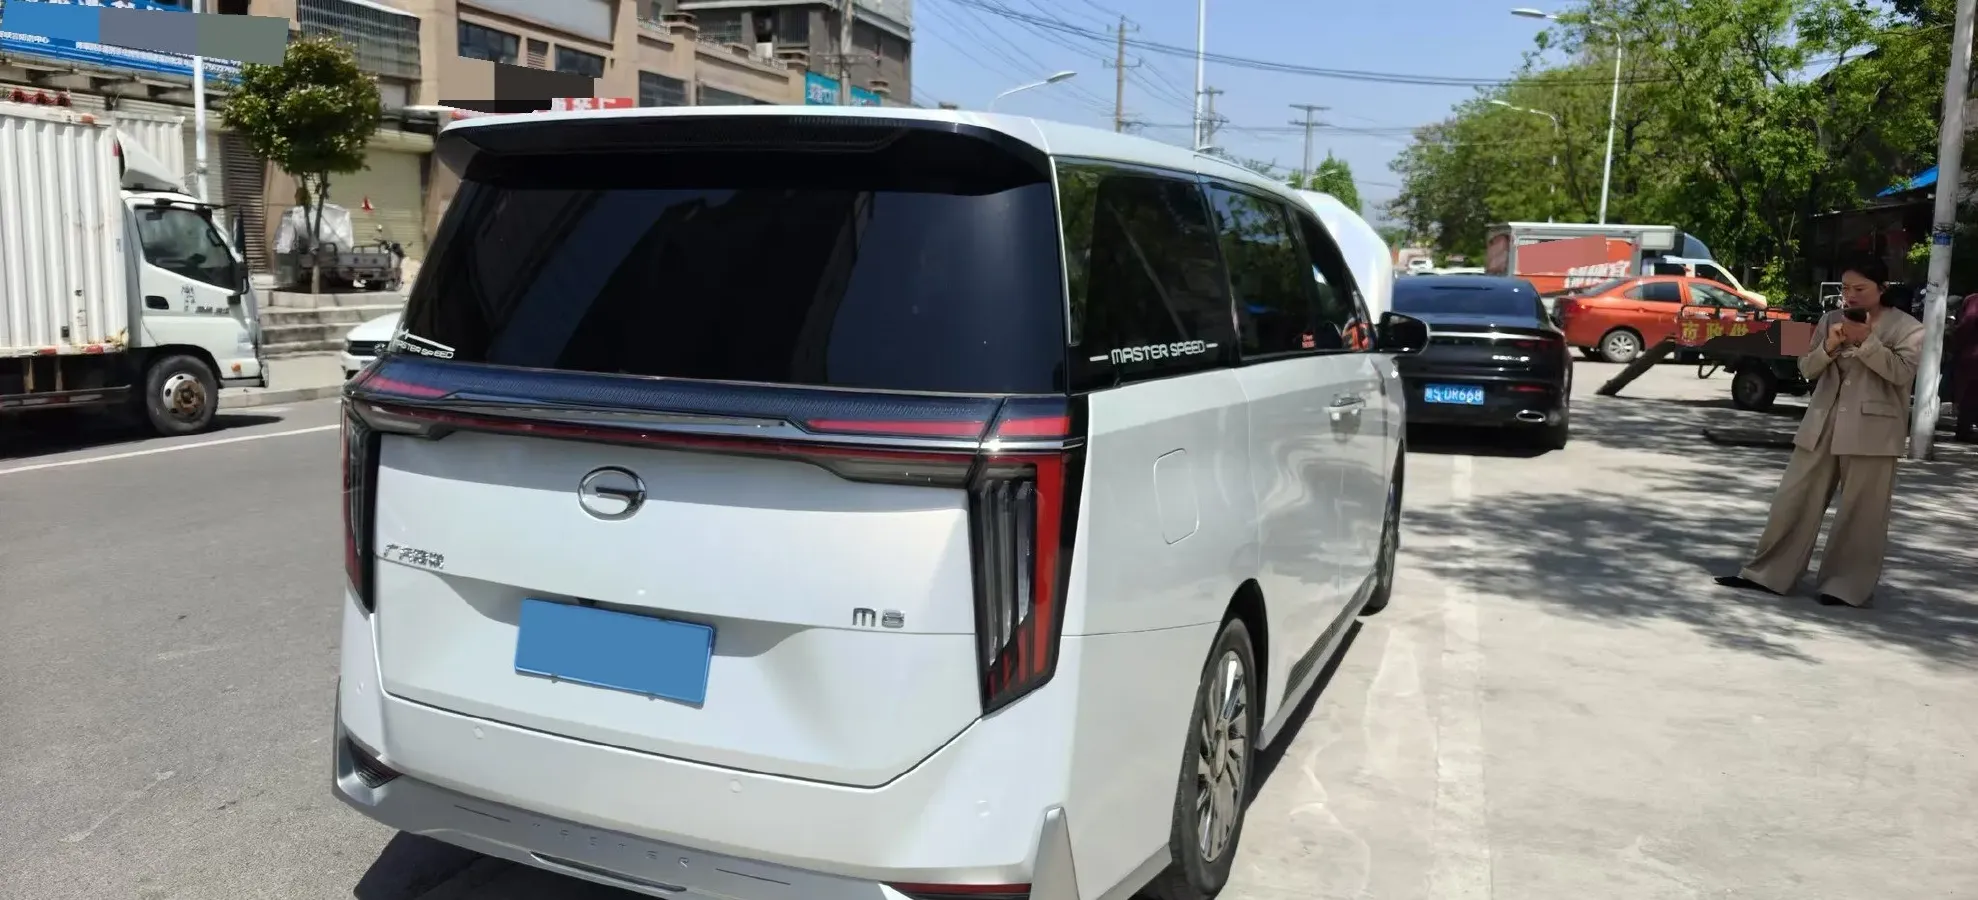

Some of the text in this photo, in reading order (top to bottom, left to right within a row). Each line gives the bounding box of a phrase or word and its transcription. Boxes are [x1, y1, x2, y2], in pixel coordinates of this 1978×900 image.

[421, 348, 454, 359] SPEED
[1110, 340, 1206, 365] MASTER SPEED
